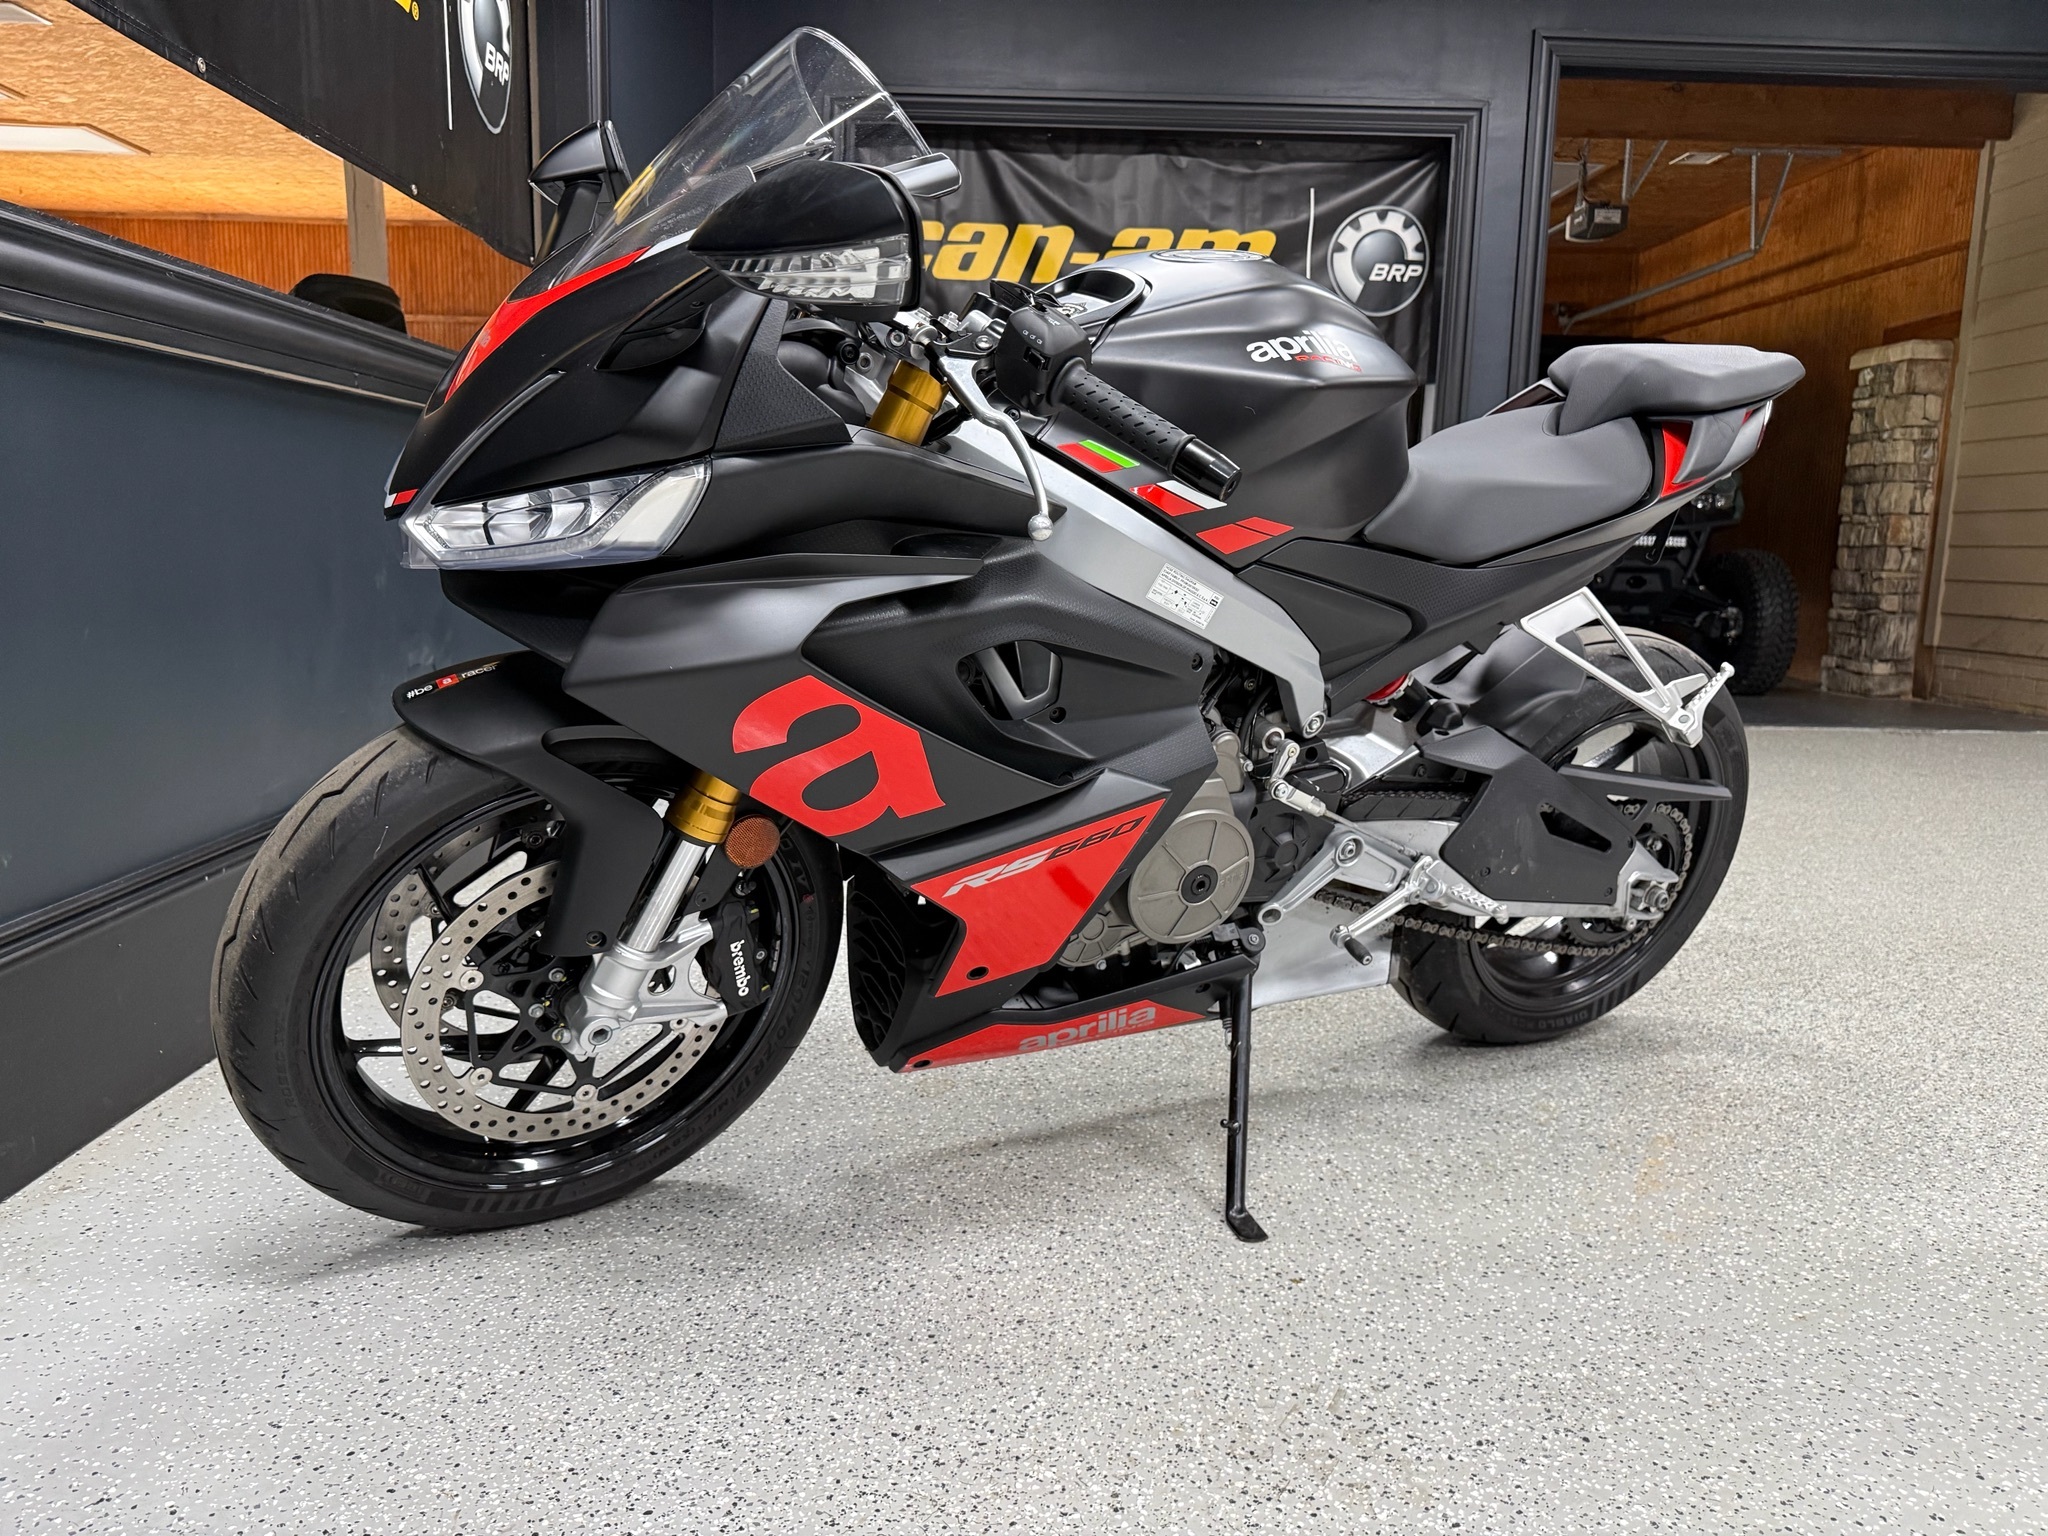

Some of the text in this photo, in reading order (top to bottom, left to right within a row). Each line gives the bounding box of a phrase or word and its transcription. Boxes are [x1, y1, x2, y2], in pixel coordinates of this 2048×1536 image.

[484, 41, 509, 86] BRP
[1369, 263, 1423, 283] BRP
[1246, 329, 1358, 363] aprilia
[406, 684, 433, 699] #be
[461, 665, 496, 679] racer
[729, 939, 751, 997] brembo
[1018, 1005, 1157, 1051] aprilia
